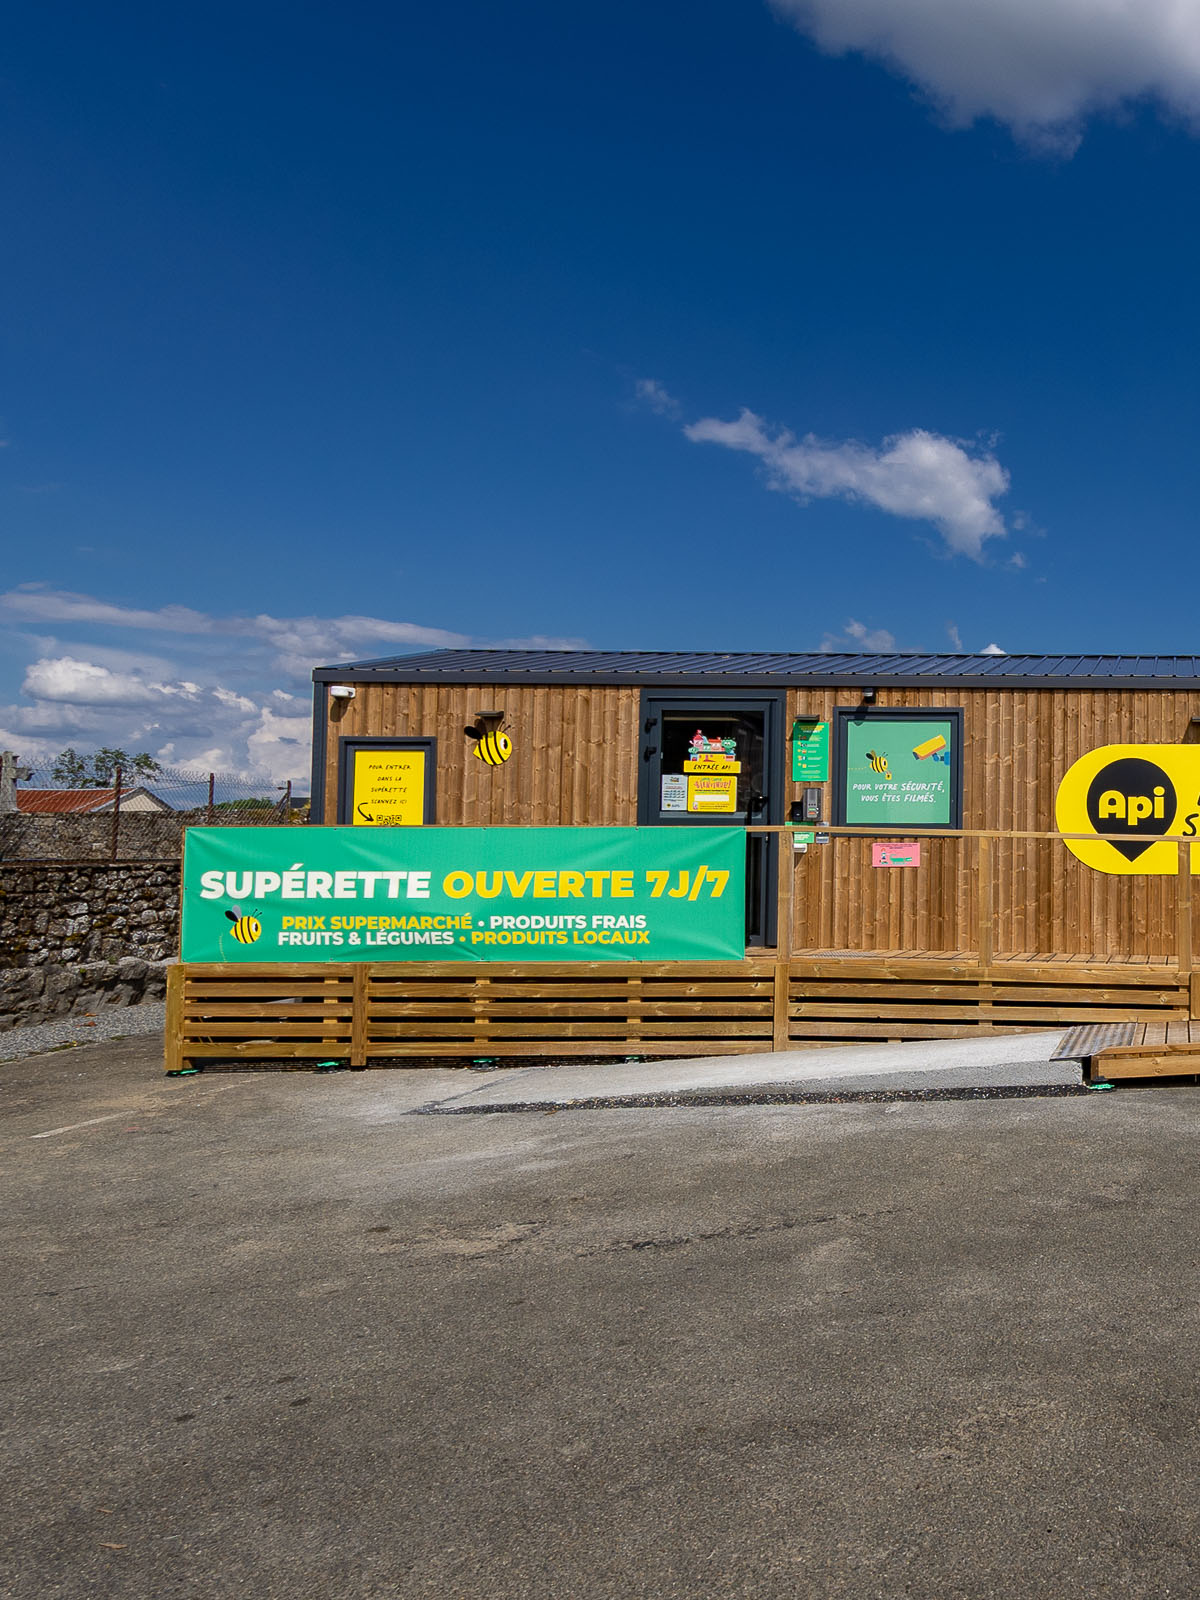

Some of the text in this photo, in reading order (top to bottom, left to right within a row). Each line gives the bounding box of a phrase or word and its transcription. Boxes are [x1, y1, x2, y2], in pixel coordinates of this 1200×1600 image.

[901, 781, 945, 793] SÉCURITÉ,
[861, 792, 936, 803] VOUS ÊTES FILMÉS.
[1099, 786, 1165, 826] Api
[200, 863, 730, 901] SUPÉRETTE OUVERTE 7J/7
[282, 913, 646, 930] PRIX SUPERMARCHÉ PRODUITS FRAIS
[278, 928, 650, 946] FRUITS & LÉGUMES PRODUITS LOCAUX
